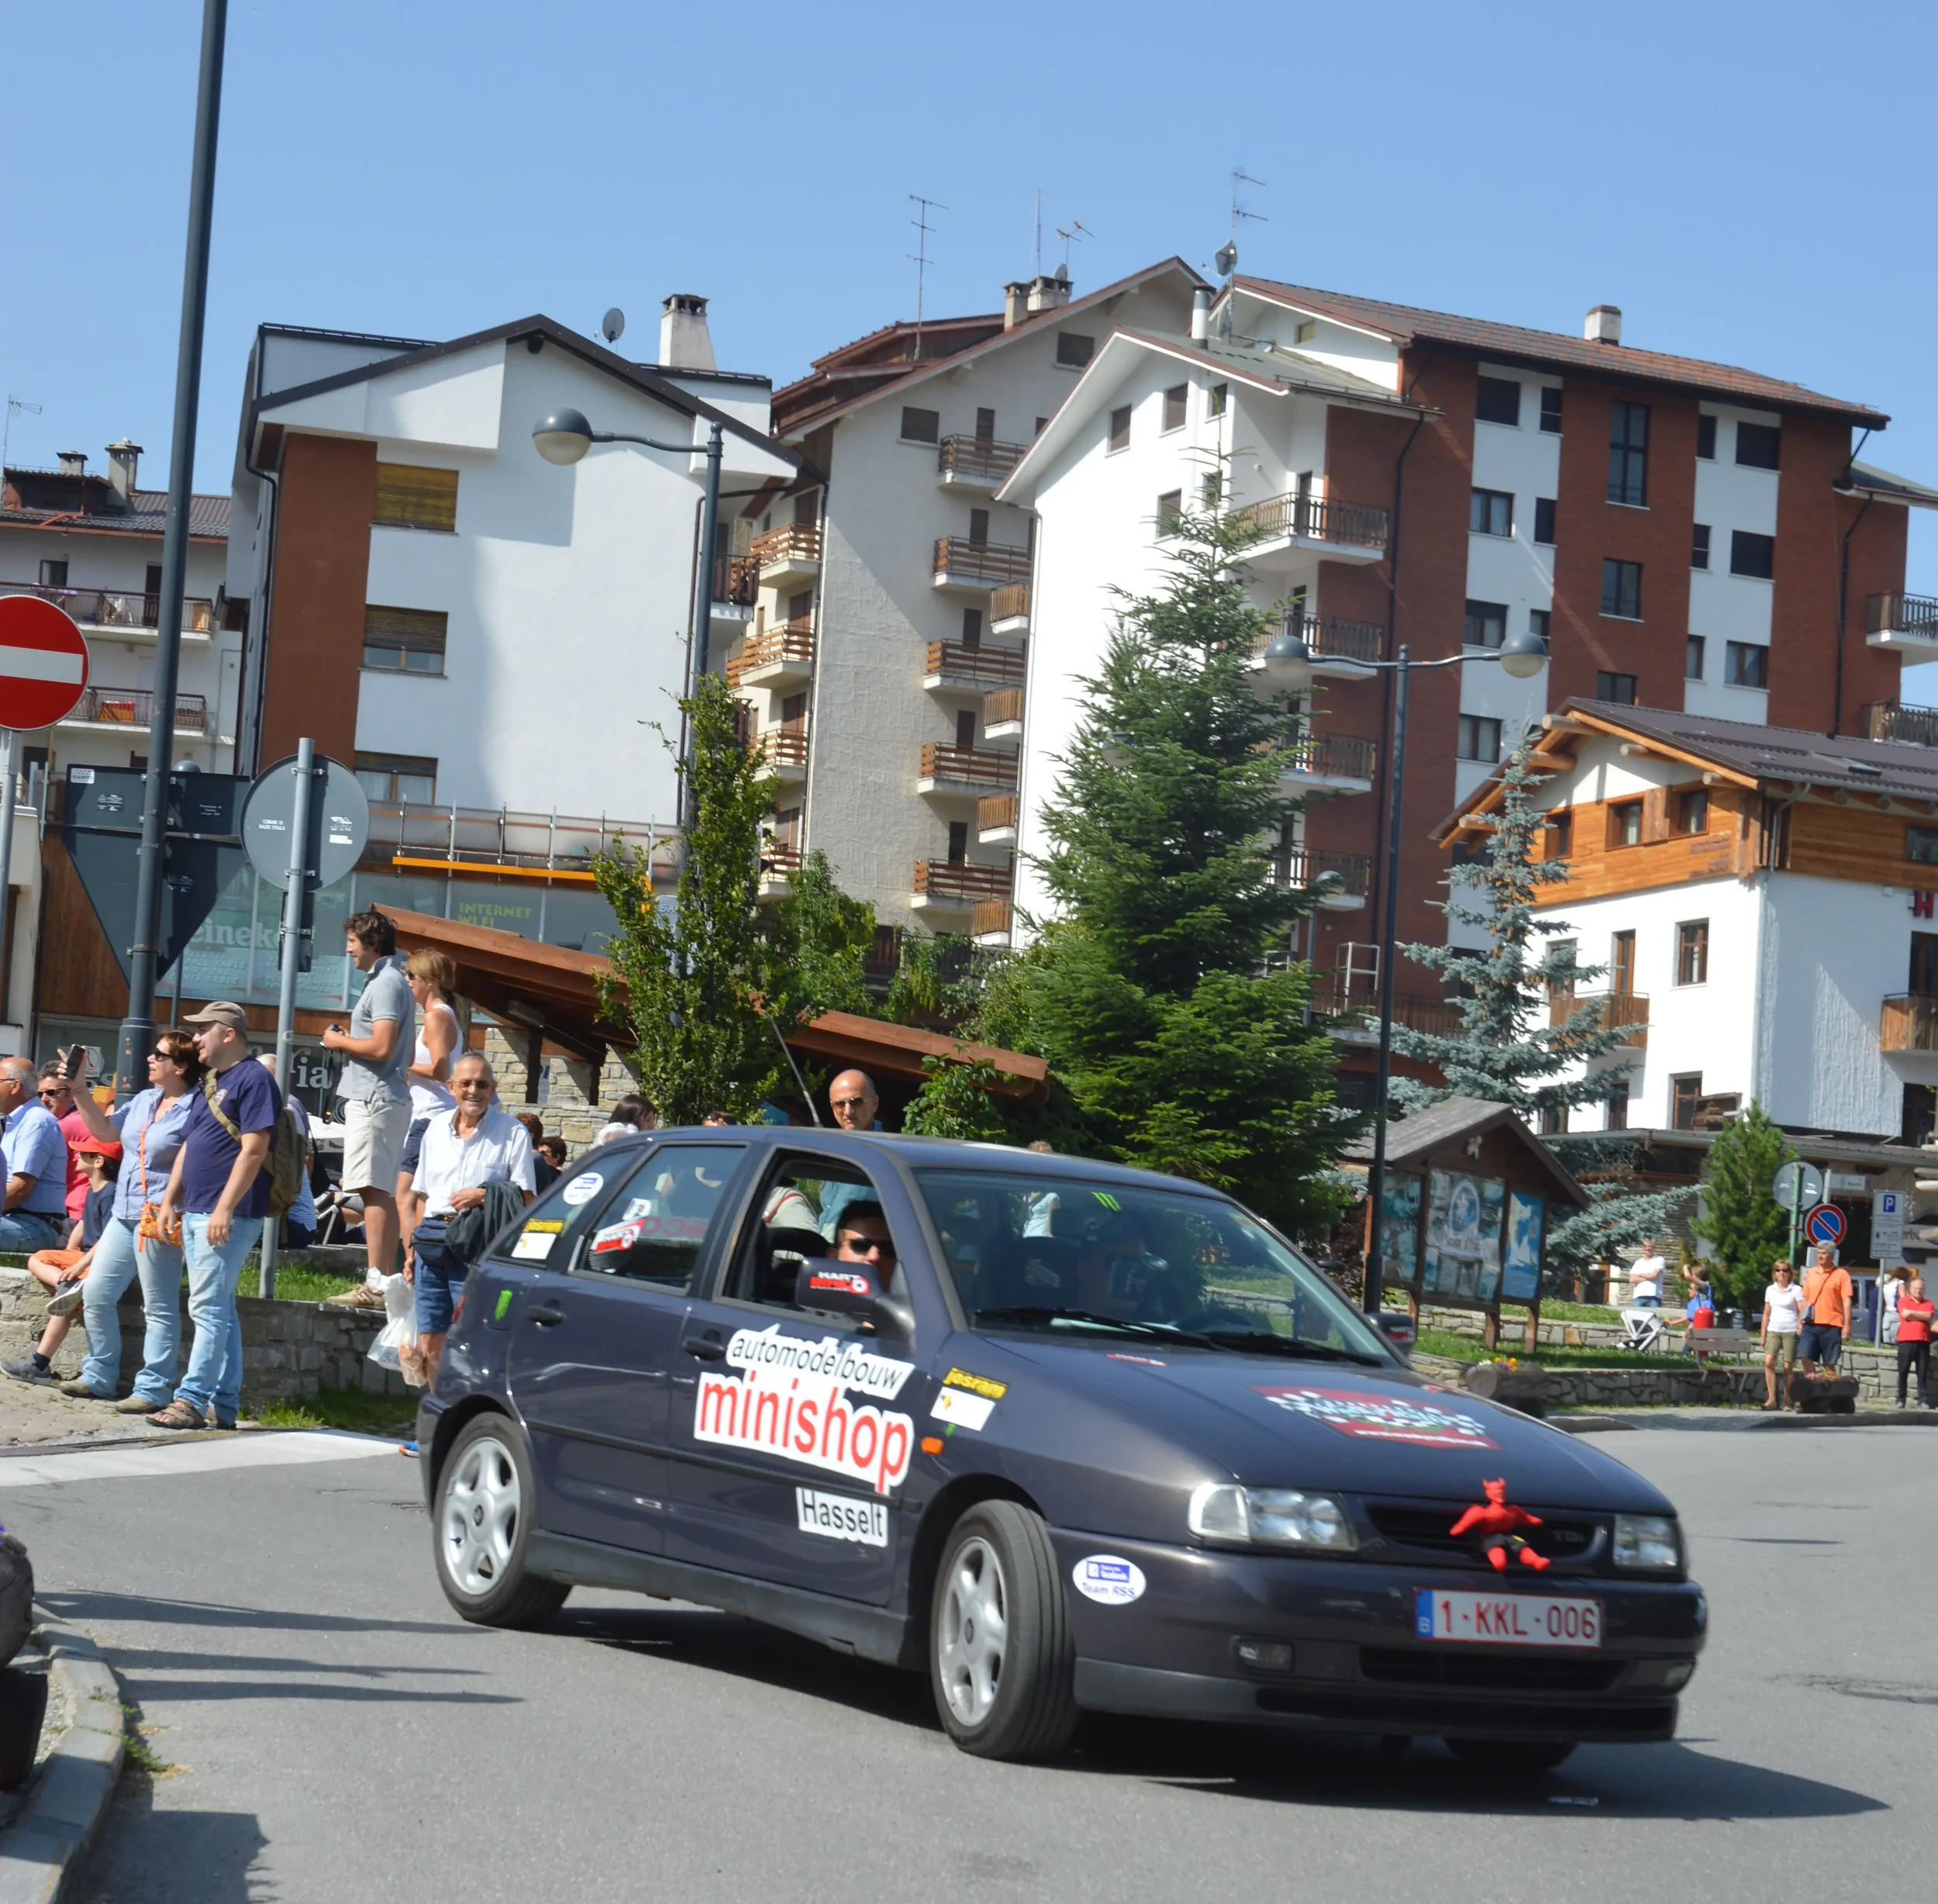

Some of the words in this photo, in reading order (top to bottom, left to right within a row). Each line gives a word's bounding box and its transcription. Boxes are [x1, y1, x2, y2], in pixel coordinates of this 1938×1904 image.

[459, 902, 533, 919] INTERNET
[1885, 1197, 1894, 1211] P
[733, 1337, 903, 1389] automodelbouw
[700, 1370, 907, 1494] minishop
[802, 1489, 883, 1537] Hasselt
[1082, 1581, 1108, 1595] Team
